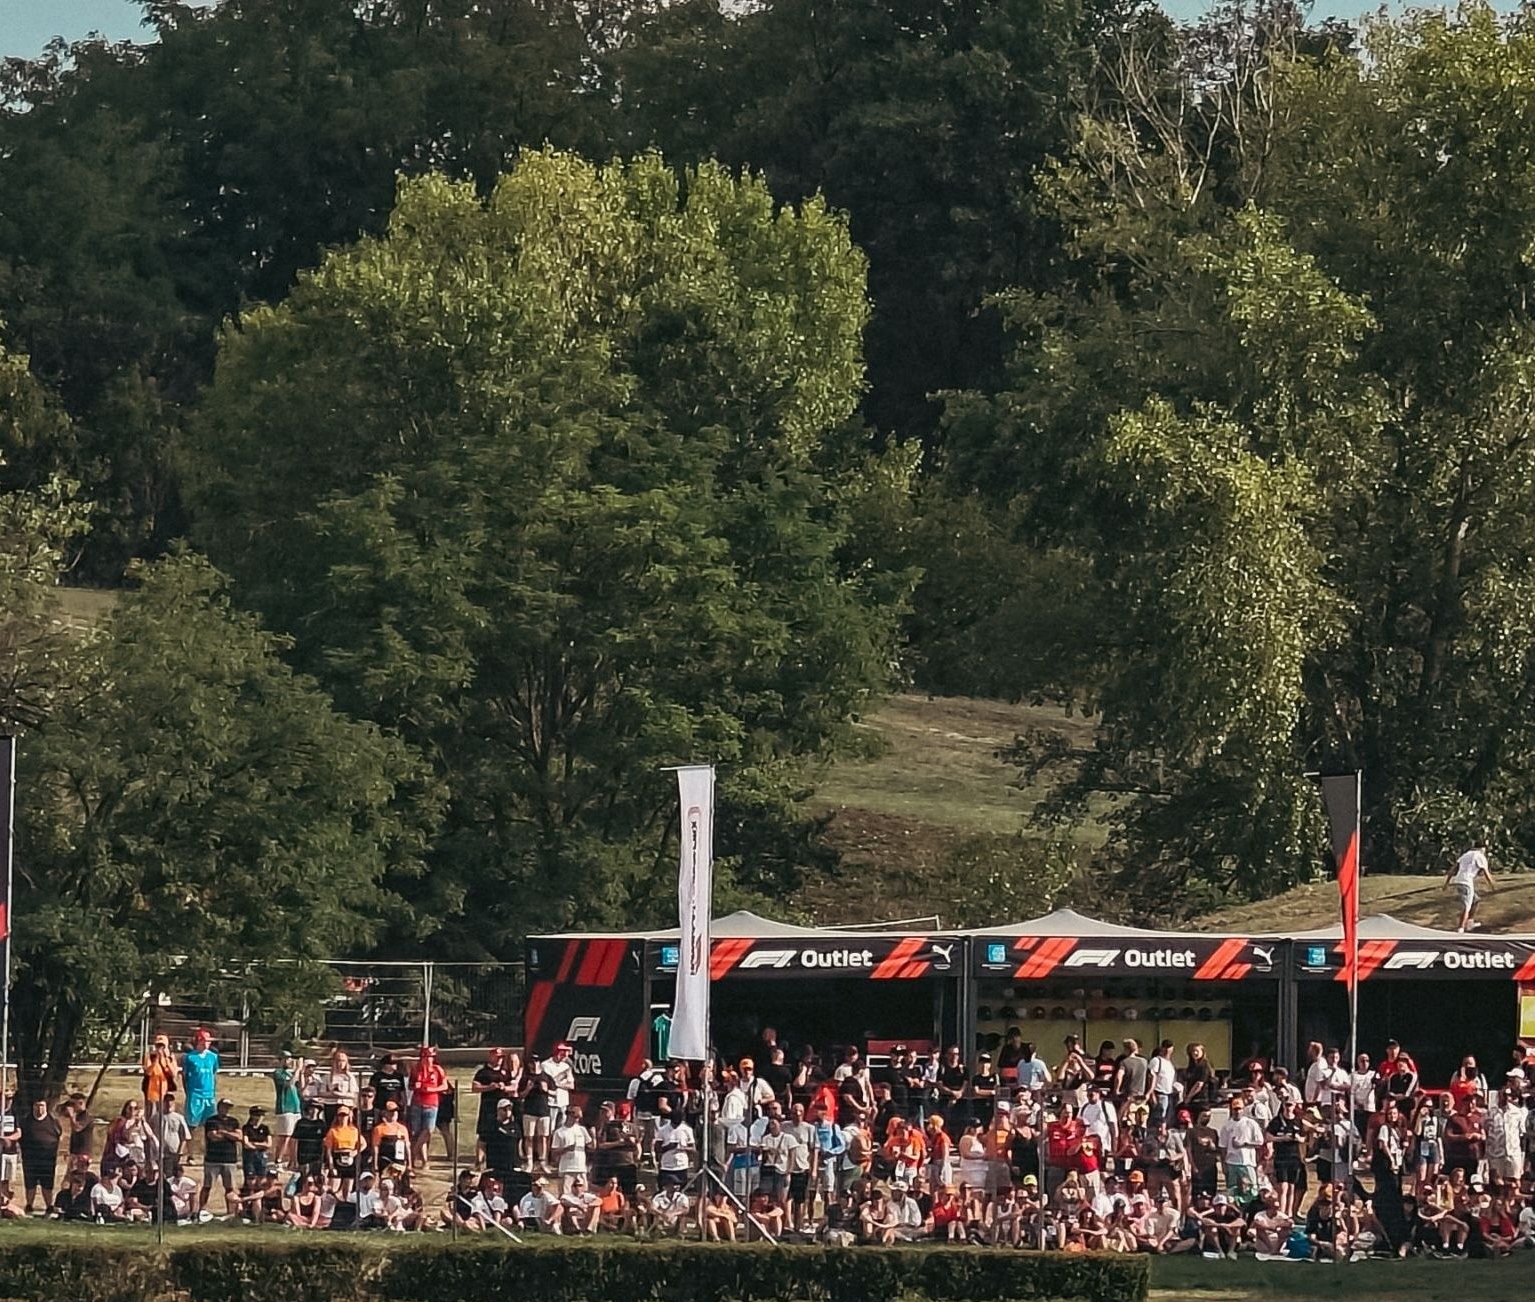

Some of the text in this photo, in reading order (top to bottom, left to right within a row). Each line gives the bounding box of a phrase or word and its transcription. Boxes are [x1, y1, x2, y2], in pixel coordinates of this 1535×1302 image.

[801, 949, 873, 968] Outlet
[1124, 949, 1196, 968] Outlet
[1443, 951, 1515, 969] Outlet
[569, 1052, 602, 1075] tore
